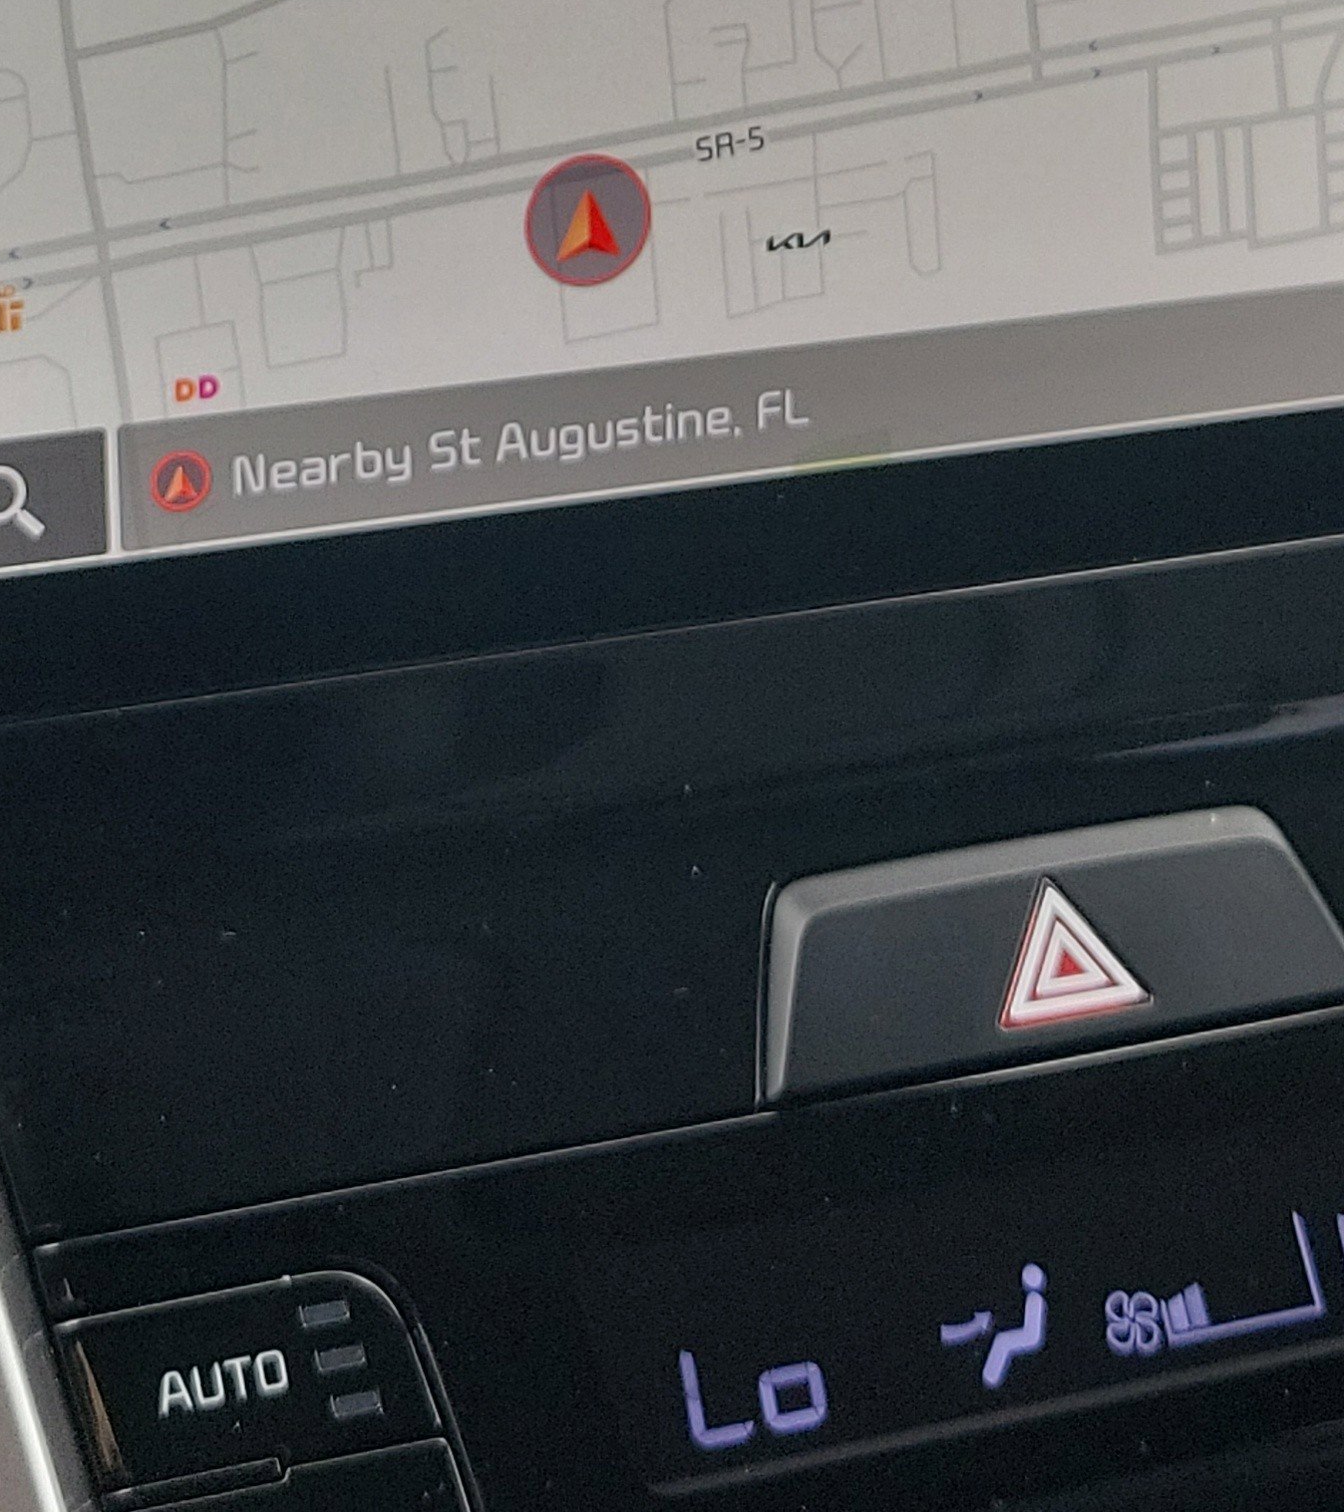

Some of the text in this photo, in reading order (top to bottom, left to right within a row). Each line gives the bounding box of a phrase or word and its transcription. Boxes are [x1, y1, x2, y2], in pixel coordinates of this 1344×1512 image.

[695, 125, 767, 164] SR-5
[230, 387, 810, 497] Nearby St Augustine, FL
[158, 1348, 290, 1420] AUTO
[678, 1348, 830, 1451] Lo
